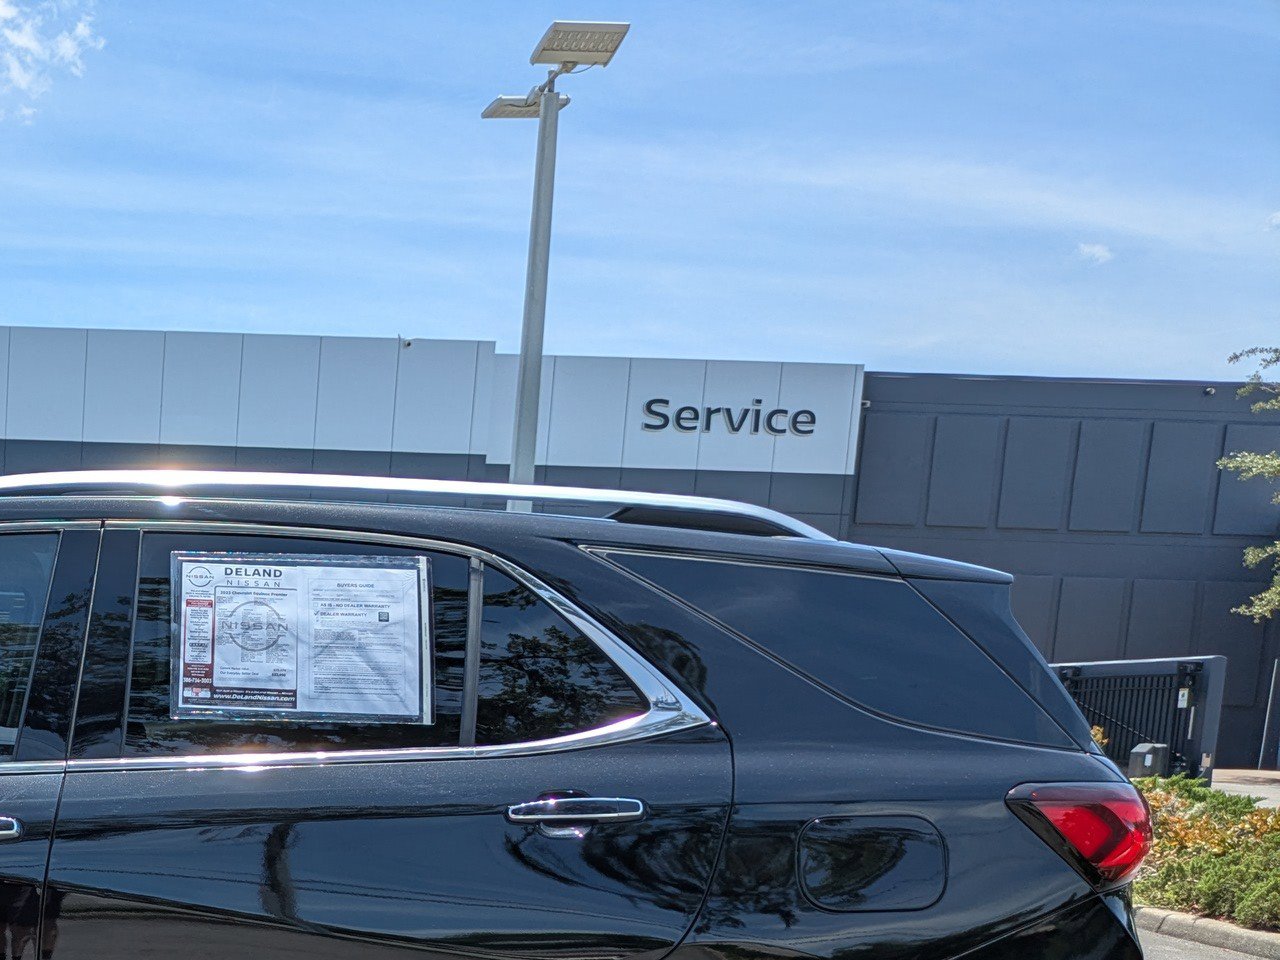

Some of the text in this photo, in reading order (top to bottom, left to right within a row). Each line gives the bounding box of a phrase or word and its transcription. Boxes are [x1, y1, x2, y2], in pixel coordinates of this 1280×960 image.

[641, 398, 816, 437] Service
[224, 567, 282, 577] DELAND
[226, 579, 280, 587] NISSAN
[221, 621, 288, 631] NISSAN
[214, 693, 295, 701] www.DeLandNissan.com
